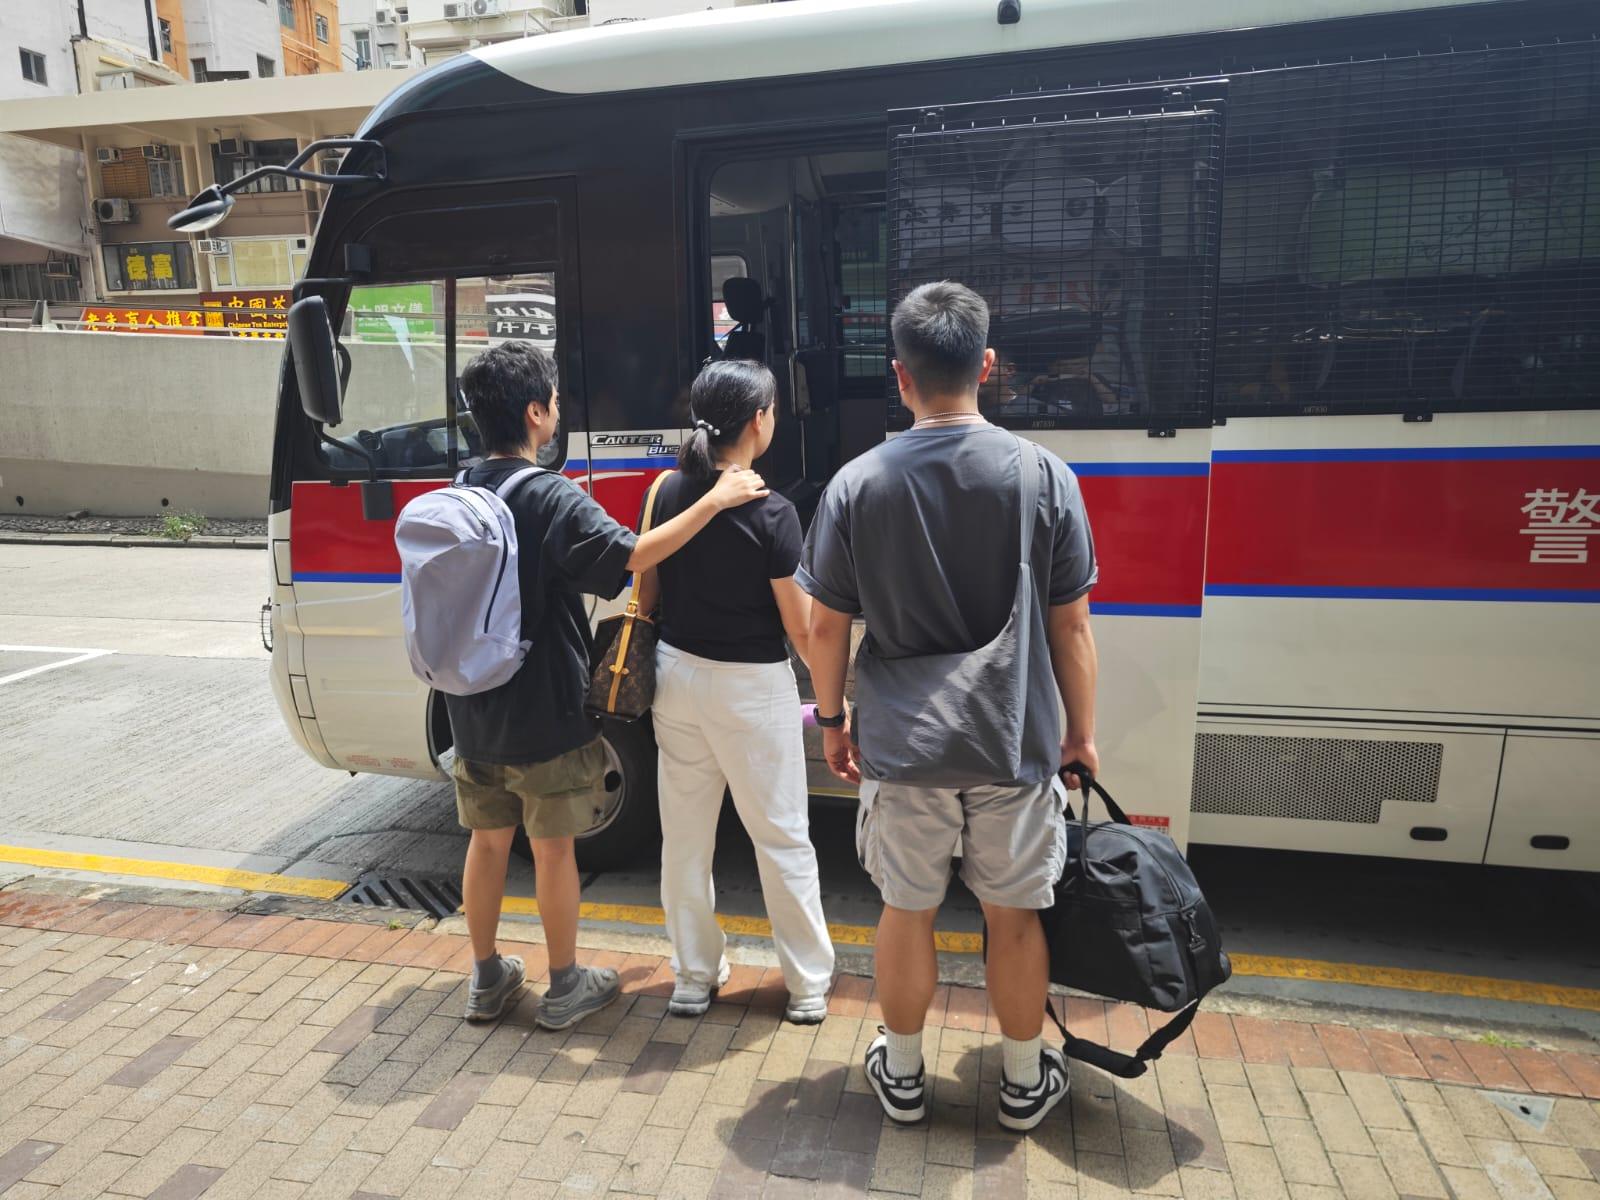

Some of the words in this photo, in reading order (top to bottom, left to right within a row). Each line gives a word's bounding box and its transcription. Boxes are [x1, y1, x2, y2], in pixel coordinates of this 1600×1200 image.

[228, 295, 287, 320] 中國茶
[591, 434, 662, 445] CANTER
[648, 445, 680, 455] BUS
[1519, 487, 1600, 564] 警
